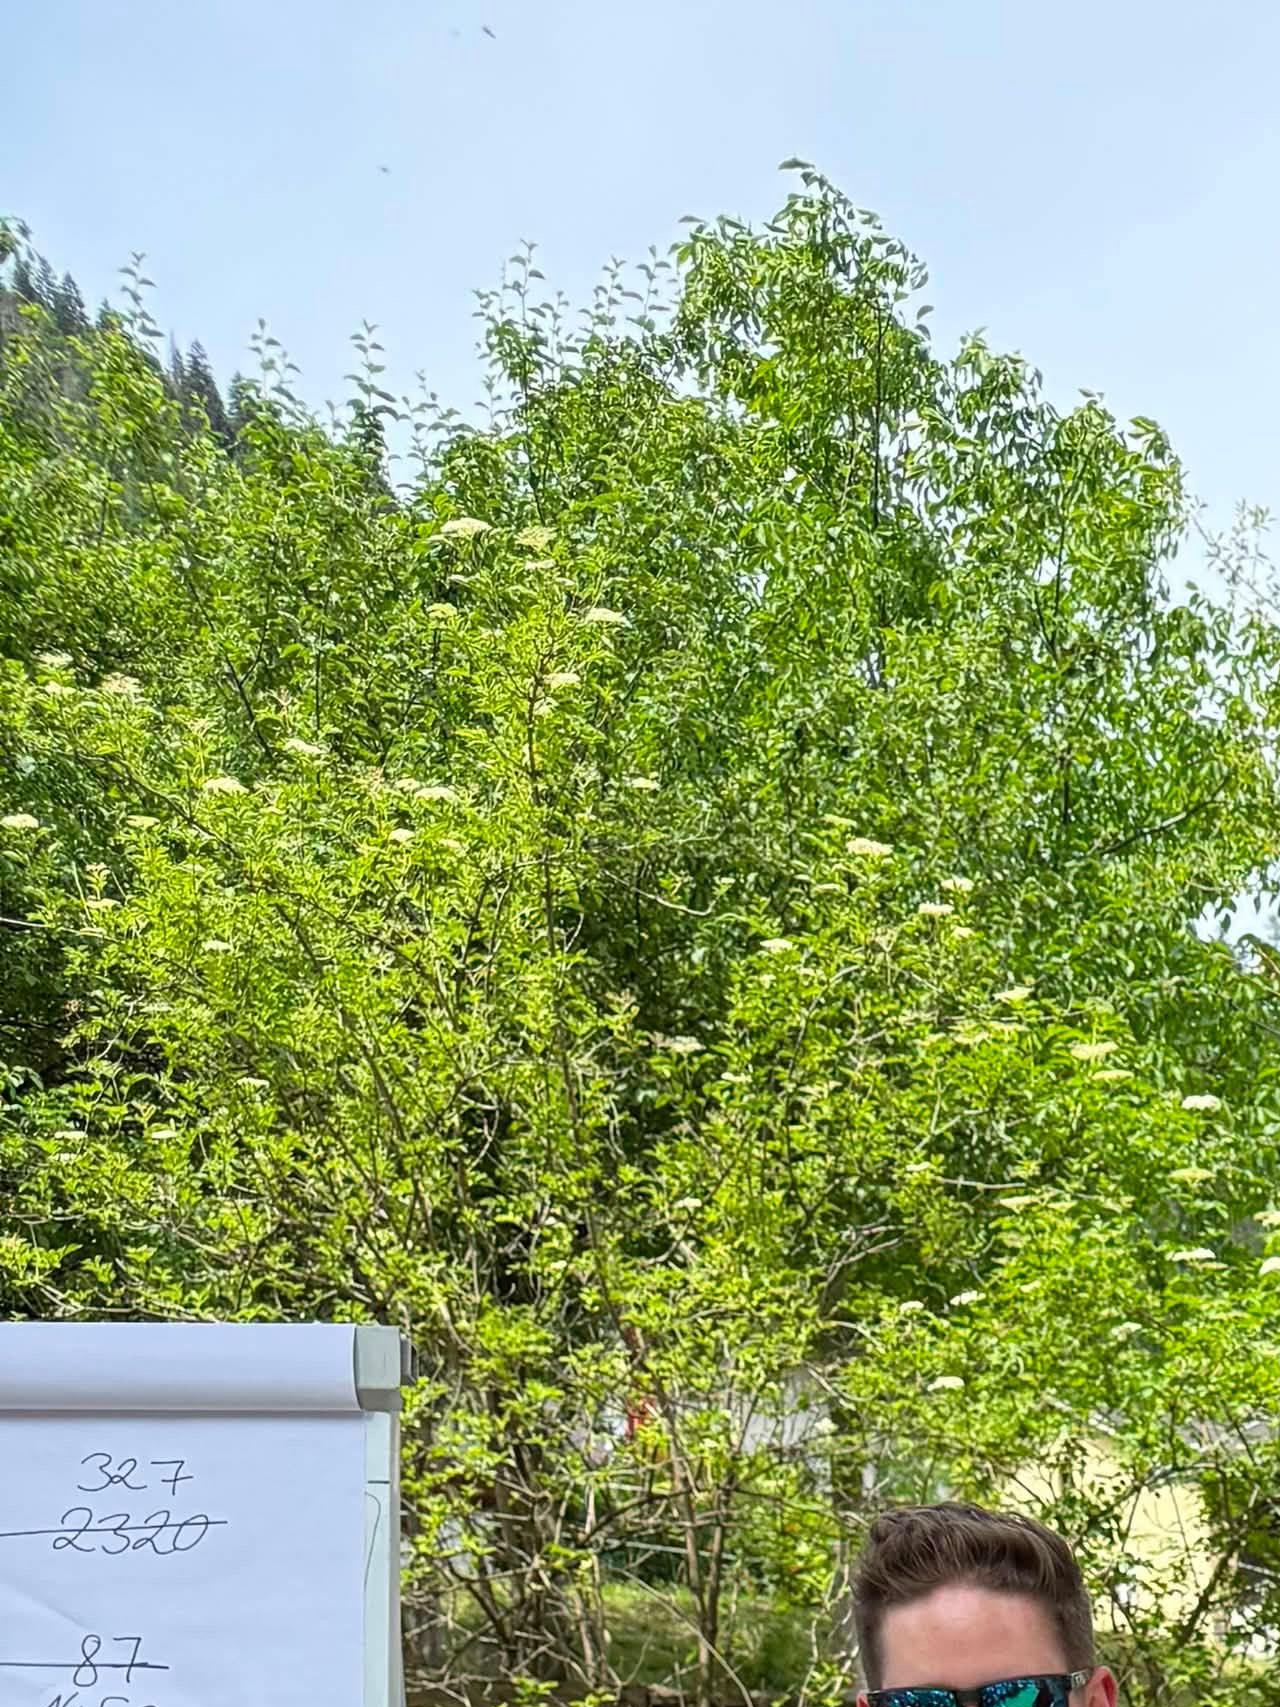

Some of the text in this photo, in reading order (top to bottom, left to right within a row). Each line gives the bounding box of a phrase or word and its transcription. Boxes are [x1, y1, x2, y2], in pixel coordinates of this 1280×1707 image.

[77, 1452, 194, 1496] 327
[52, 1507, 210, 1555] 2320
[73, 1634, 149, 1688] 87
